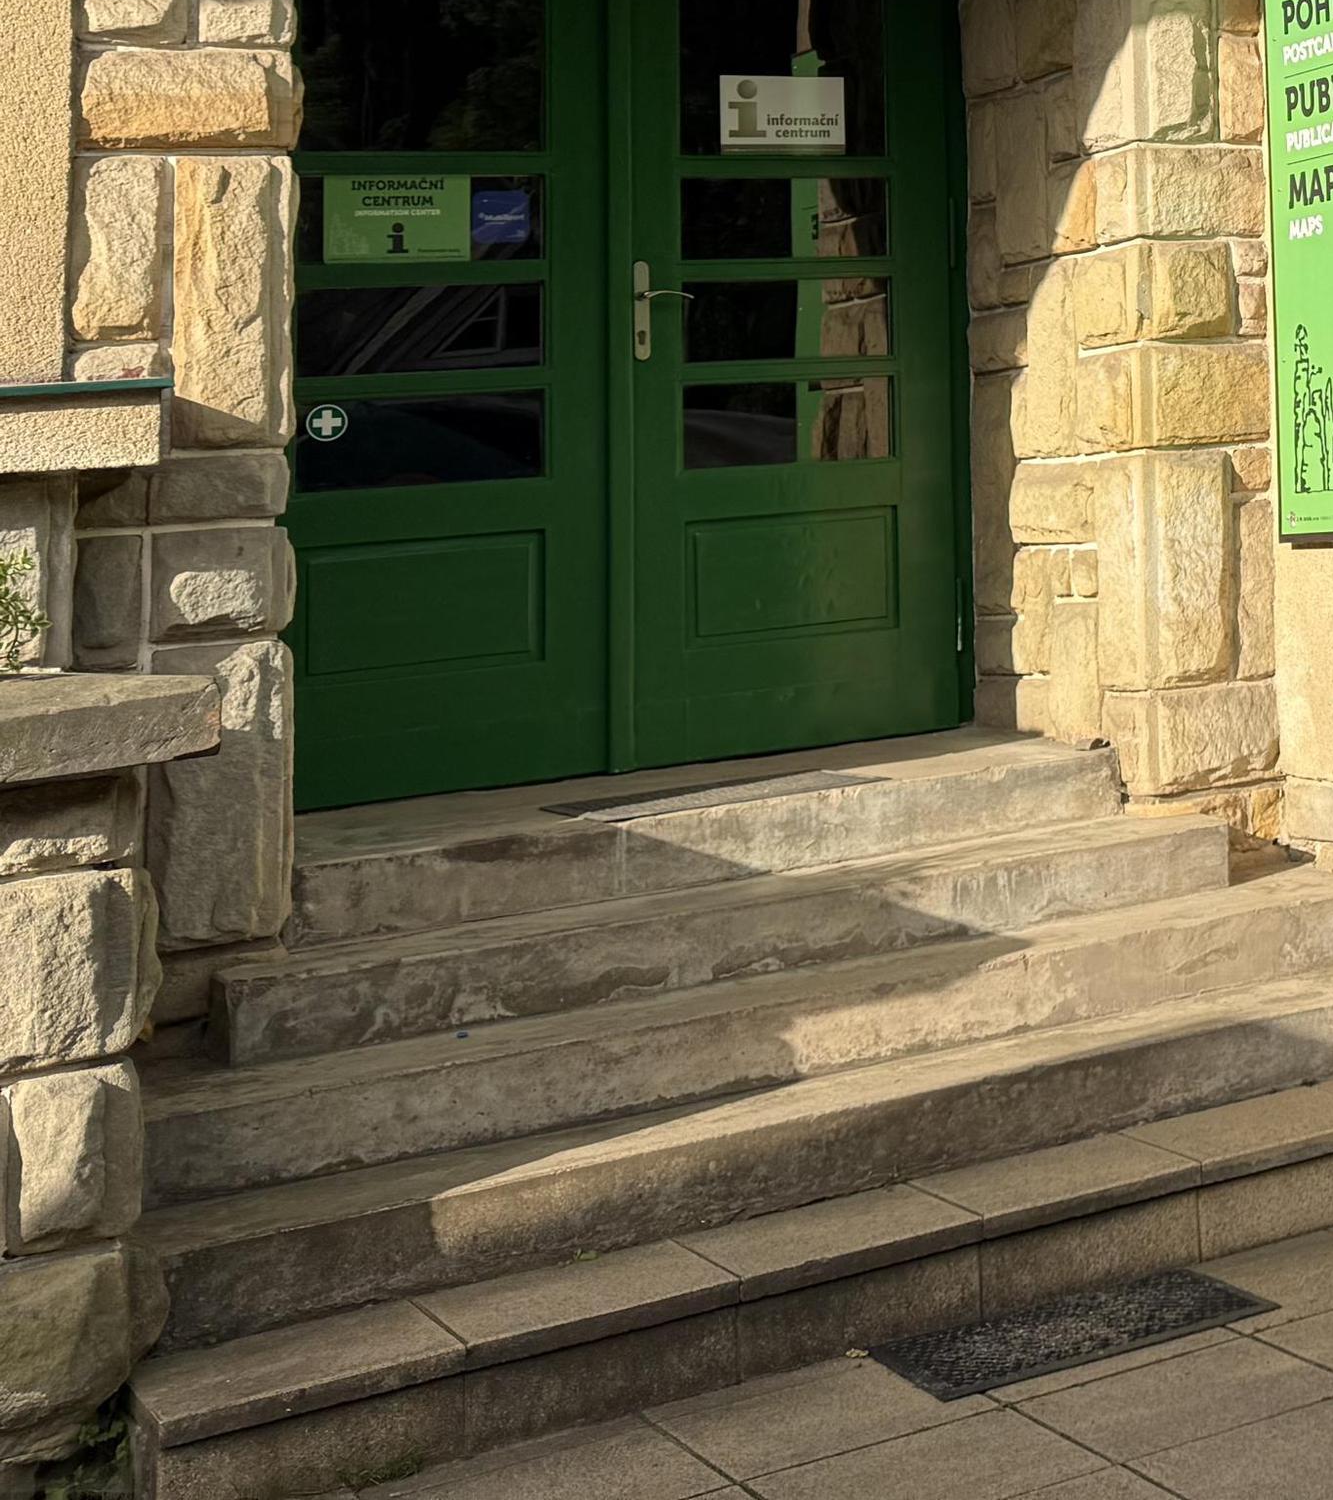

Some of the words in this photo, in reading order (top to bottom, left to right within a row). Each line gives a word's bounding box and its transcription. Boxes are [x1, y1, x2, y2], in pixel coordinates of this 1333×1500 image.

[766, 113, 840, 127] informační
[775, 128, 831, 138] centrum
[351, 176, 445, 191] INFORMAČNÍ
[361, 195, 435, 208] CENTRUM
[1288, 214, 1324, 240] MAPS
